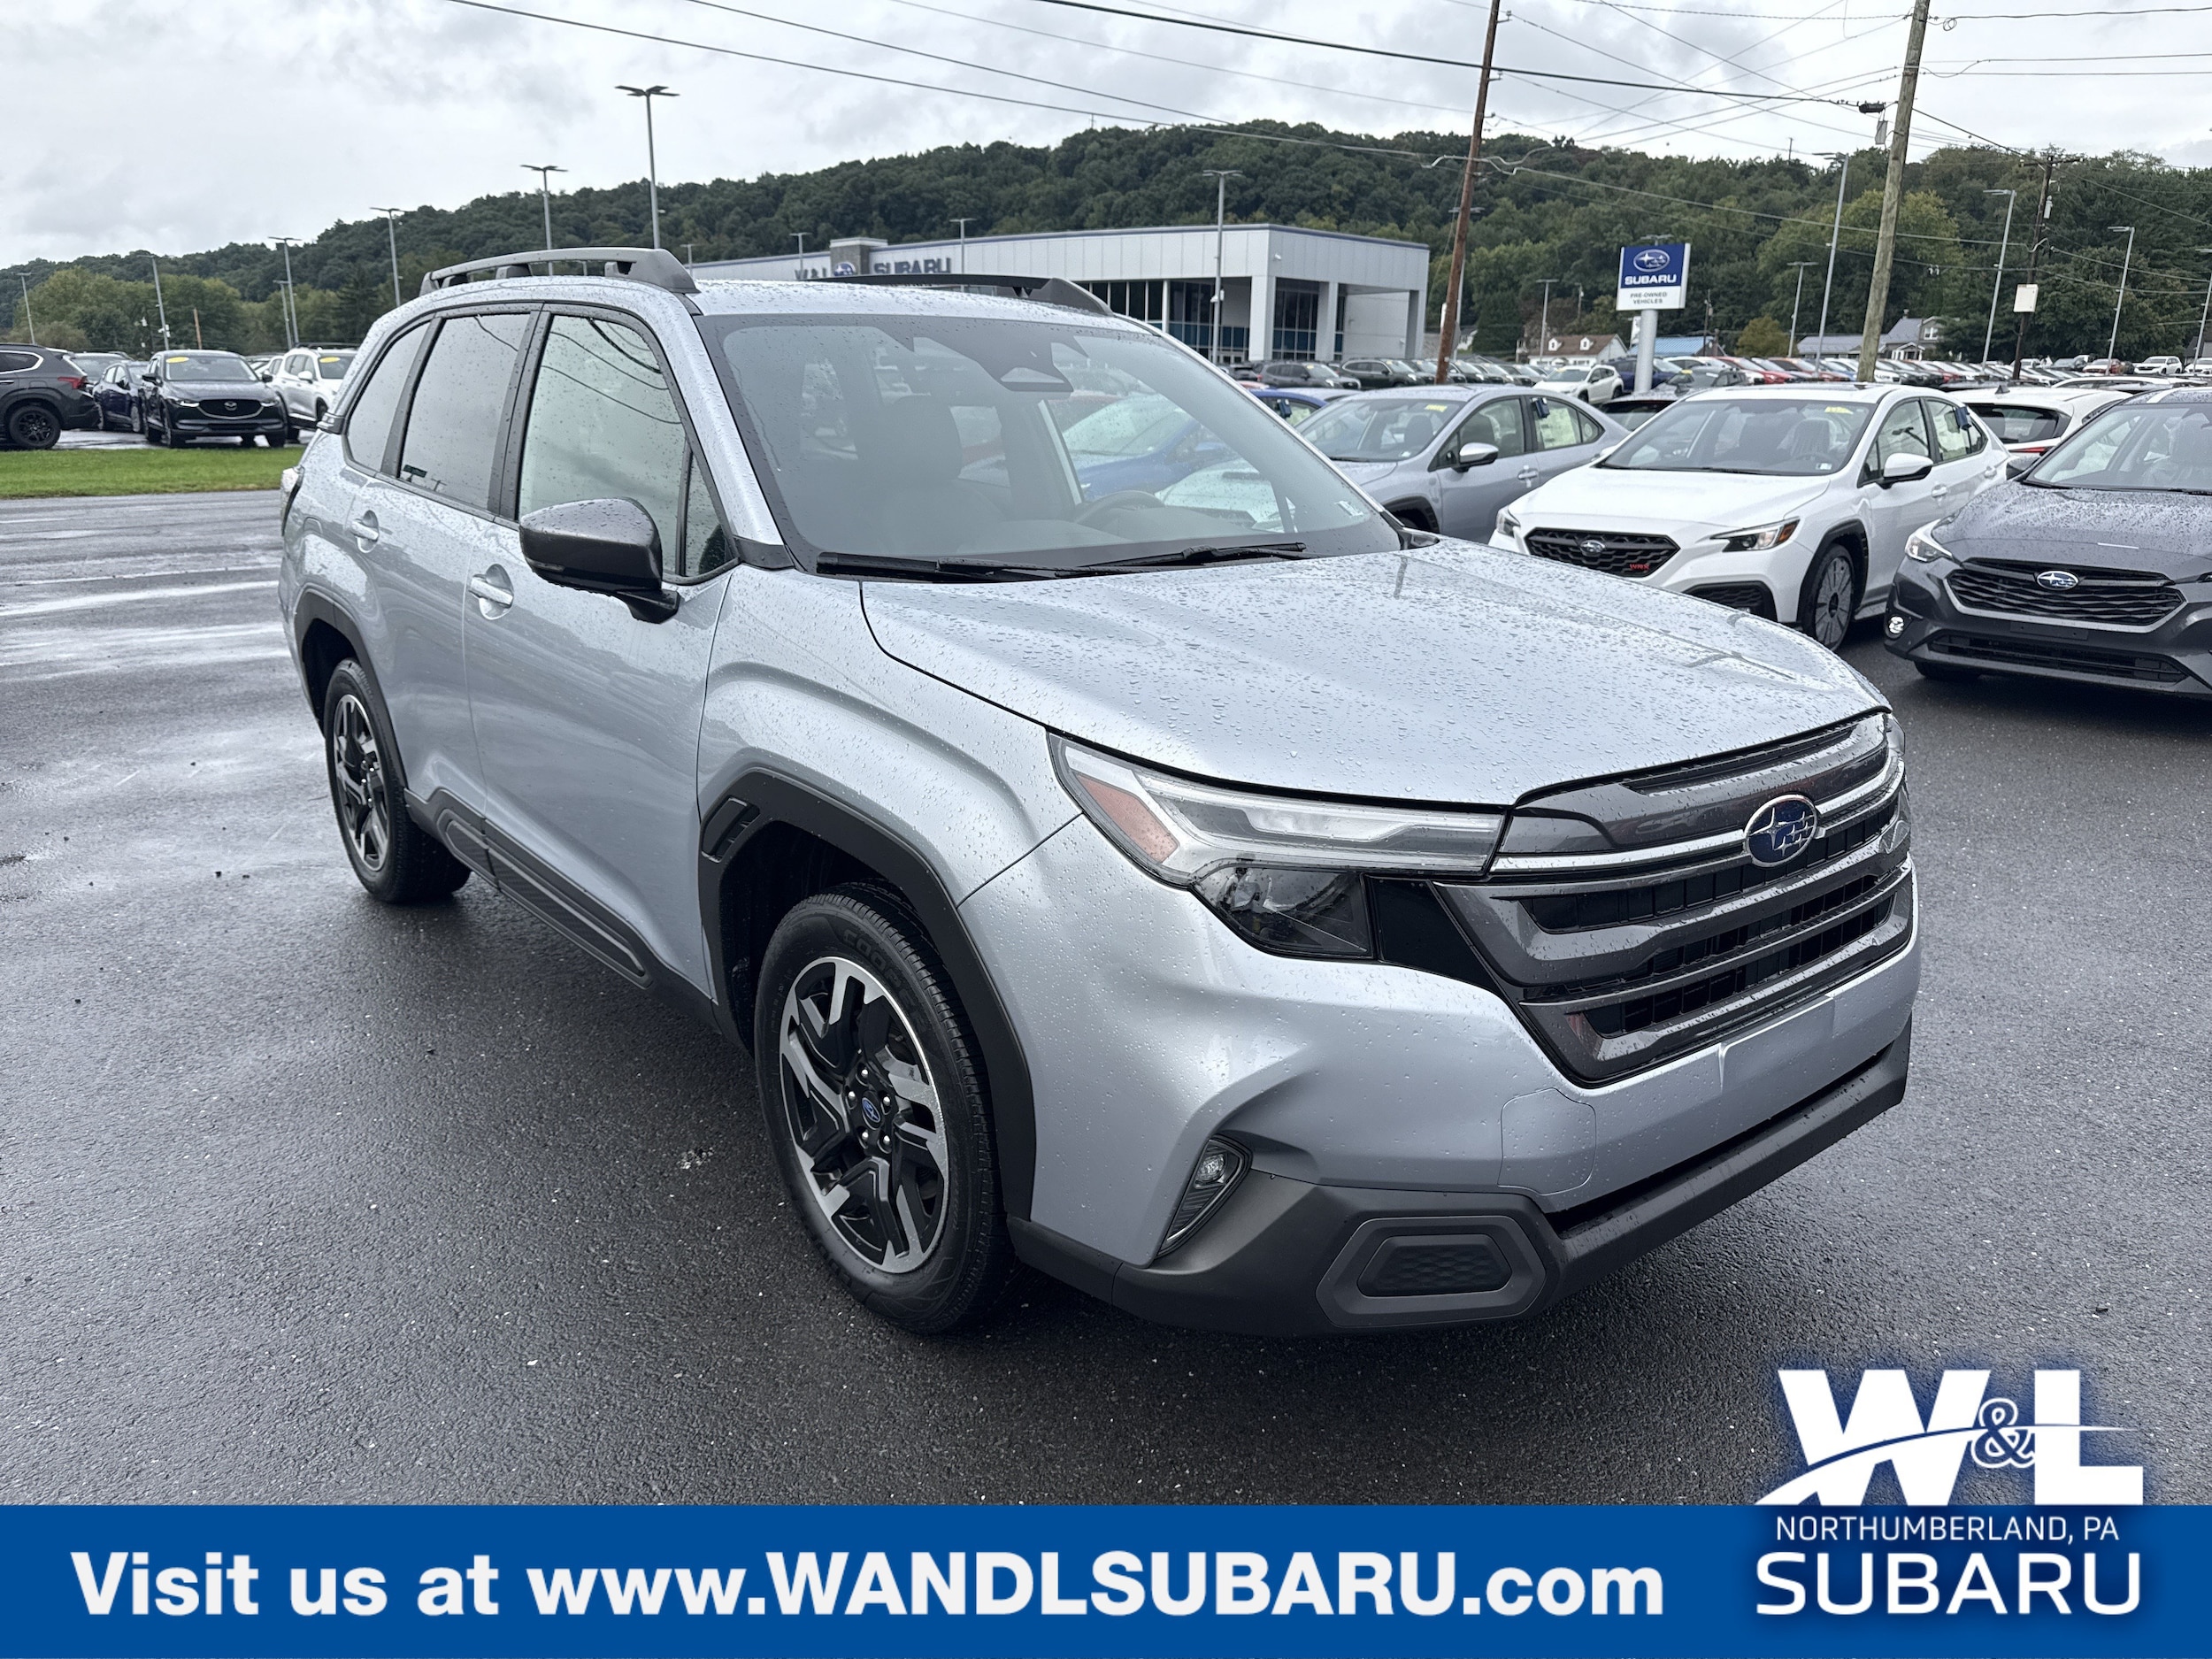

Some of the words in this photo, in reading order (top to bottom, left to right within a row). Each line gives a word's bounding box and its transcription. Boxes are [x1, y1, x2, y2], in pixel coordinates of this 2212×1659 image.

[874, 257, 951, 273] SUBARU
[1624, 274, 1677, 285] SUBARU
[843, 929, 928, 1033] COOPER
